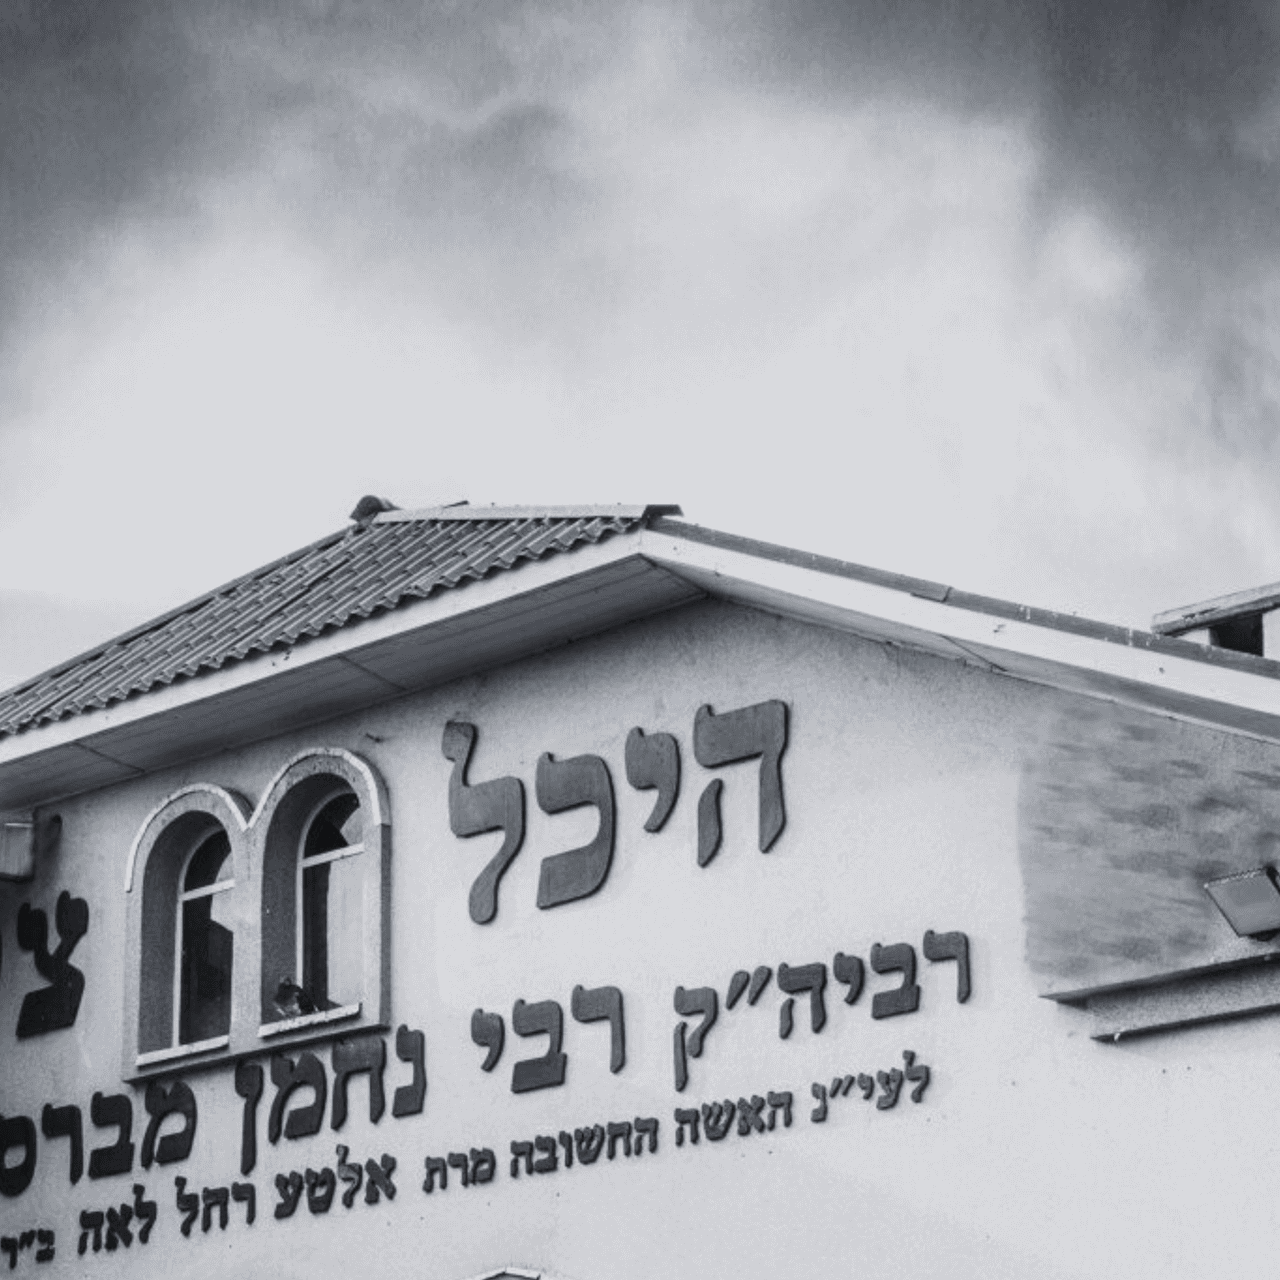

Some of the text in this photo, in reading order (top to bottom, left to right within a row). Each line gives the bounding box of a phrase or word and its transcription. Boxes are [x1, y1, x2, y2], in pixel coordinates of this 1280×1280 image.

[443, 700, 792, 925] היכל
[471, 986, 626, 1094] רבי
[234, 1024, 428, 1177] נחמן
[675, 1085, 793, 1147] האשה
[274, 1146, 397, 1220] אלטע
[423, 1148, 496, 1194] מרת
[511, 1118, 659, 1178] החשובה
[77, 1183, 157, 1256] לאה
[175, 1176, 256, 1238] רחל
